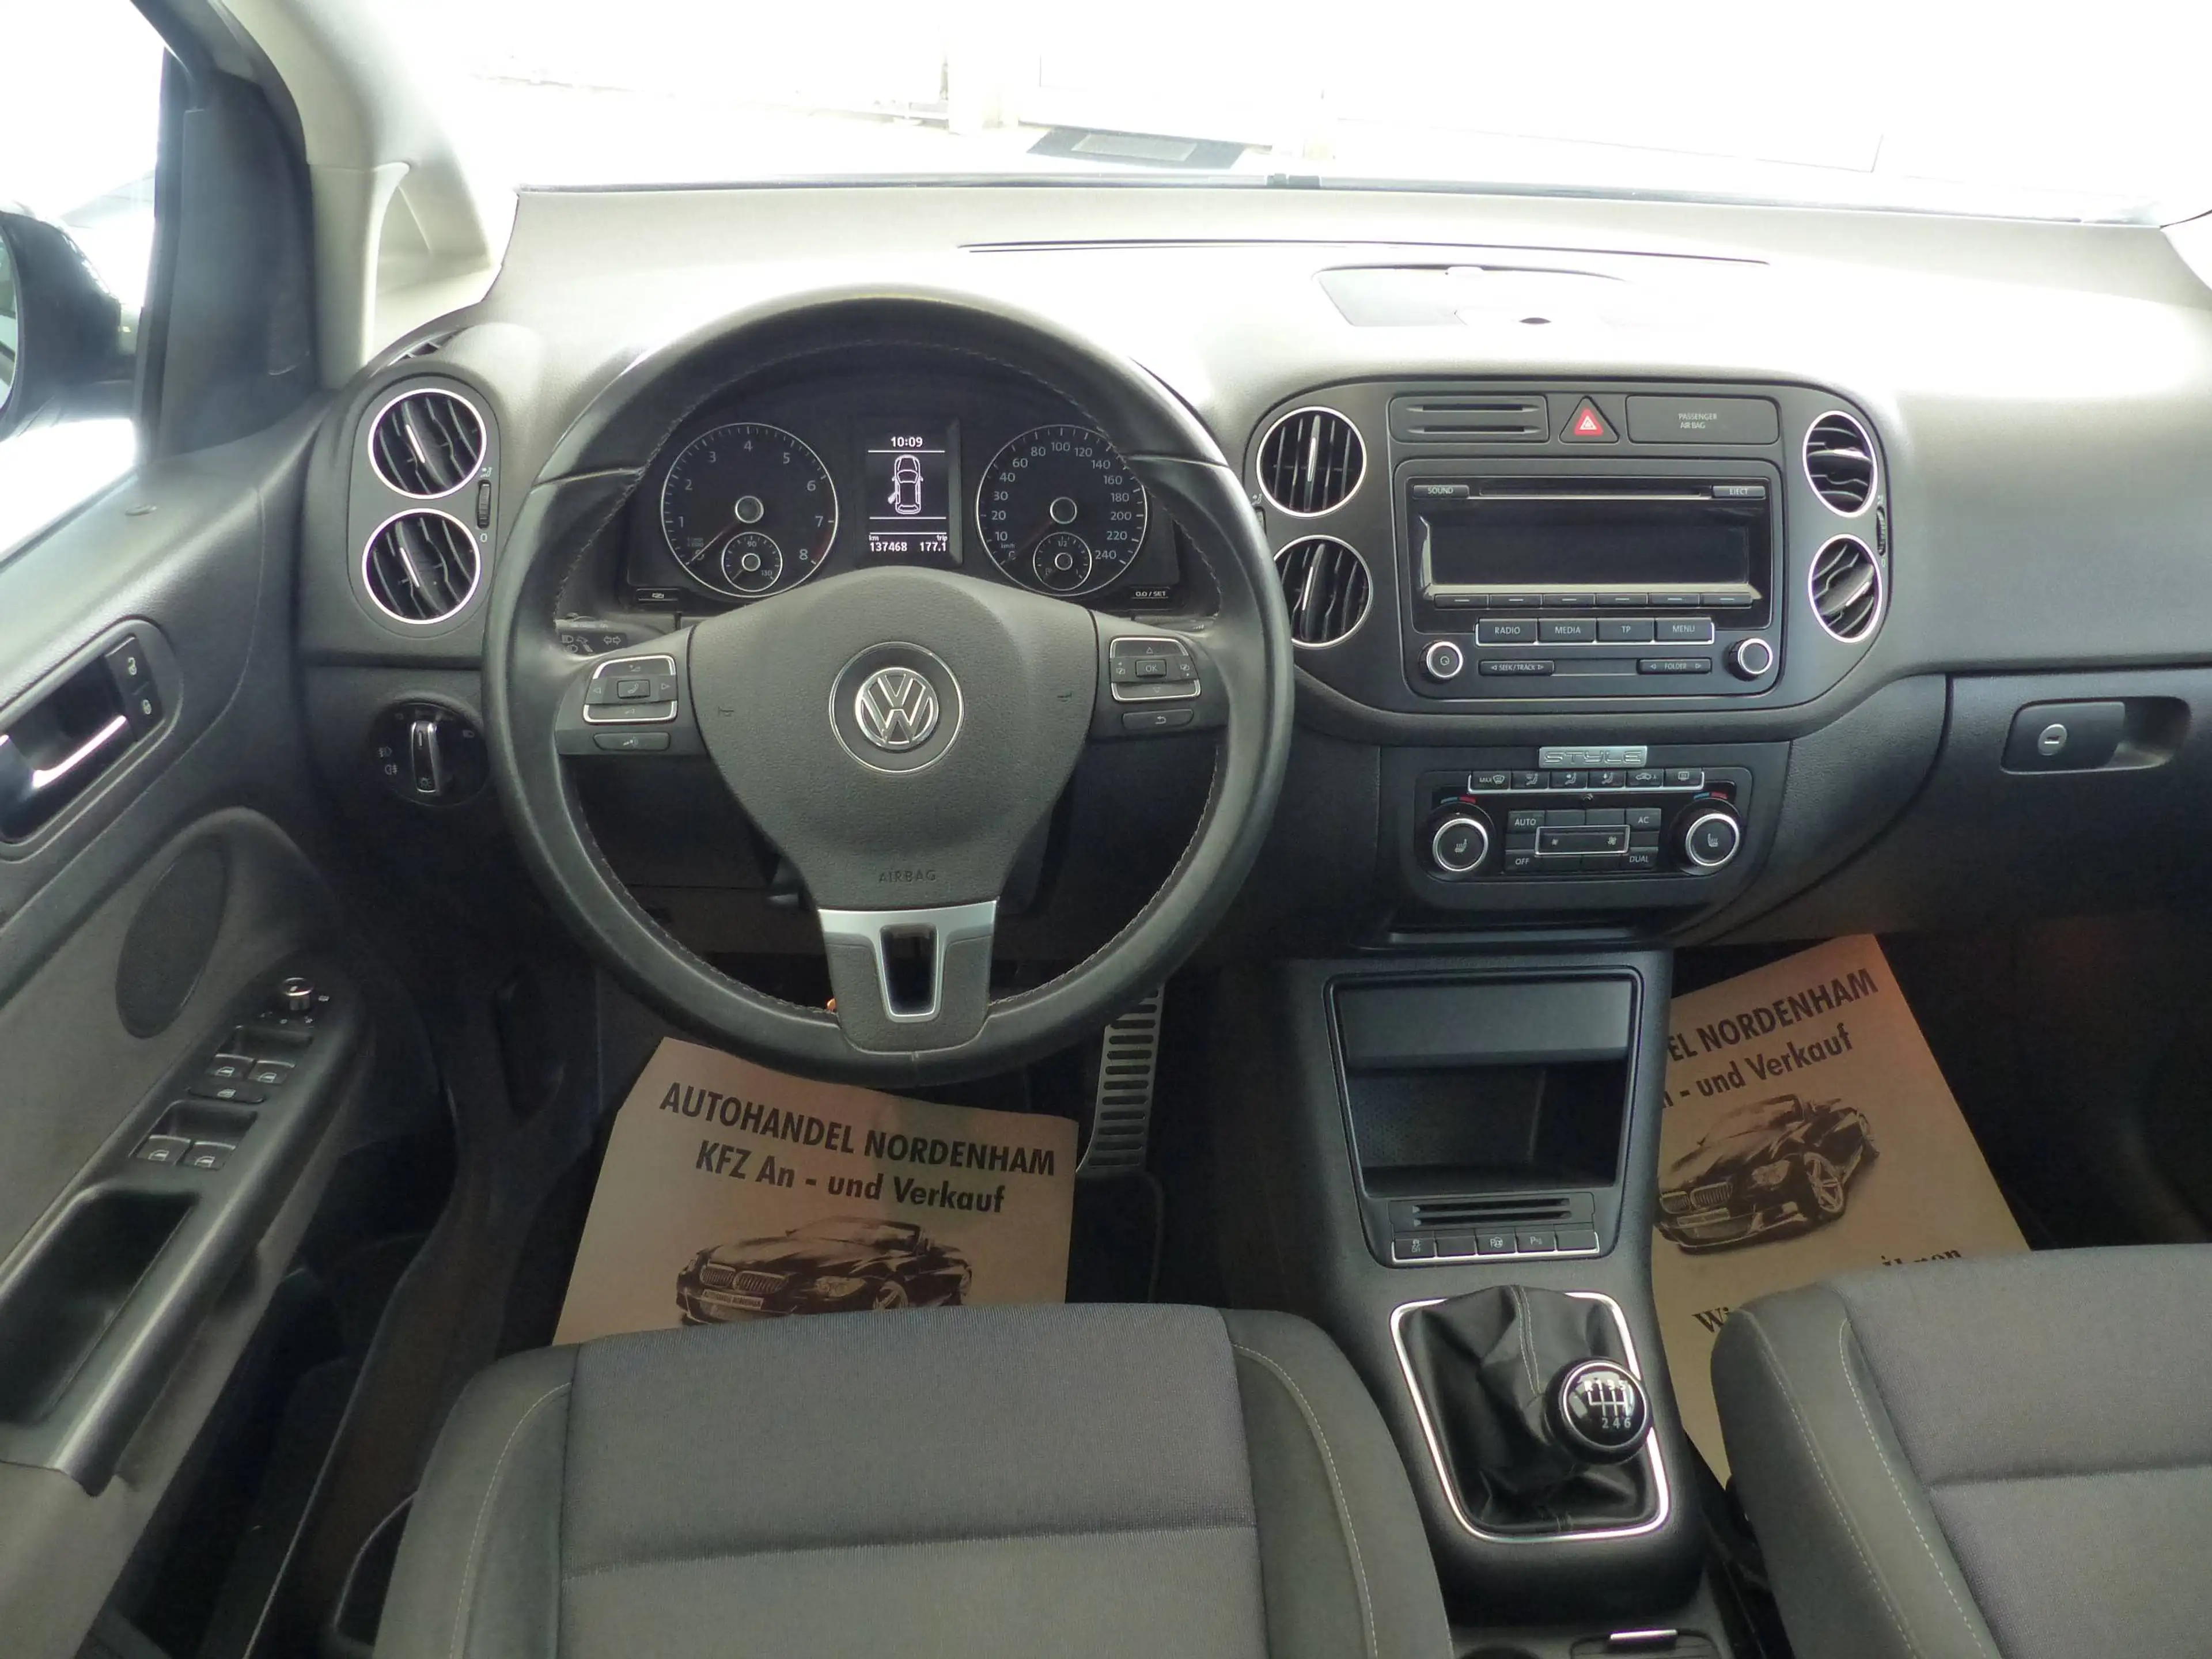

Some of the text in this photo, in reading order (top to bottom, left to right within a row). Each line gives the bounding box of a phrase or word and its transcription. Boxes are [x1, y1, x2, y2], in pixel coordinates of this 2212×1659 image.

[744, 440, 753, 452] 4
[891, 437, 923, 447] 10:09
[1051, 441, 1071, 452] 100
[1031, 446, 1046, 457] 80
[1074, 447, 1093, 457] 120
[710, 451, 717, 463] 3
[783, 452, 790, 464] 5
[1012, 458, 1028, 468] 60
[1092, 459, 1111, 469] 140
[999, 472, 1016, 482] 40
[1103, 475, 1123, 485] 160
[685, 479, 693, 491] 2
[806, 480, 816, 491] 6
[994, 491, 1009, 501] 30
[1111, 492, 1130, 502] 180
[991, 510, 1006, 520] 20
[1111, 511, 1132, 521] 200
[815, 515, 824, 528] 7
[995, 531, 1008, 541] 10
[1107, 531, 1127, 540] 220
[870, 542, 946, 552] 137468 177.1
[799, 548, 808, 560] 8
[1095, 550, 1116, 560] 240
[1494, 626, 1521, 634] RADIO
[1555, 626, 1581, 634] MEDIA
[1672, 625, 1695, 633] MENU
[1544, 750, 1642, 764] STYLE
[1514, 818, 1536, 826] AUTO
[879, 869, 936, 882] AIRBAG
[1696, 968, 1878, 1052] NORDENHAM
[1695, 1060, 1747, 1097] und
[1744, 1022, 1853, 1081] Verkauf
[660, 1082, 1055, 1176] AUTOHANDEL NORDENHAM
[696, 1139, 754, 1179] KFZ
[755, 1155, 795, 1188] An
[827, 1173, 884, 1200] und
[893, 1175, 1006, 1213] Verkauf
[1602, 1417, 1631, 1429] 2 4 6
